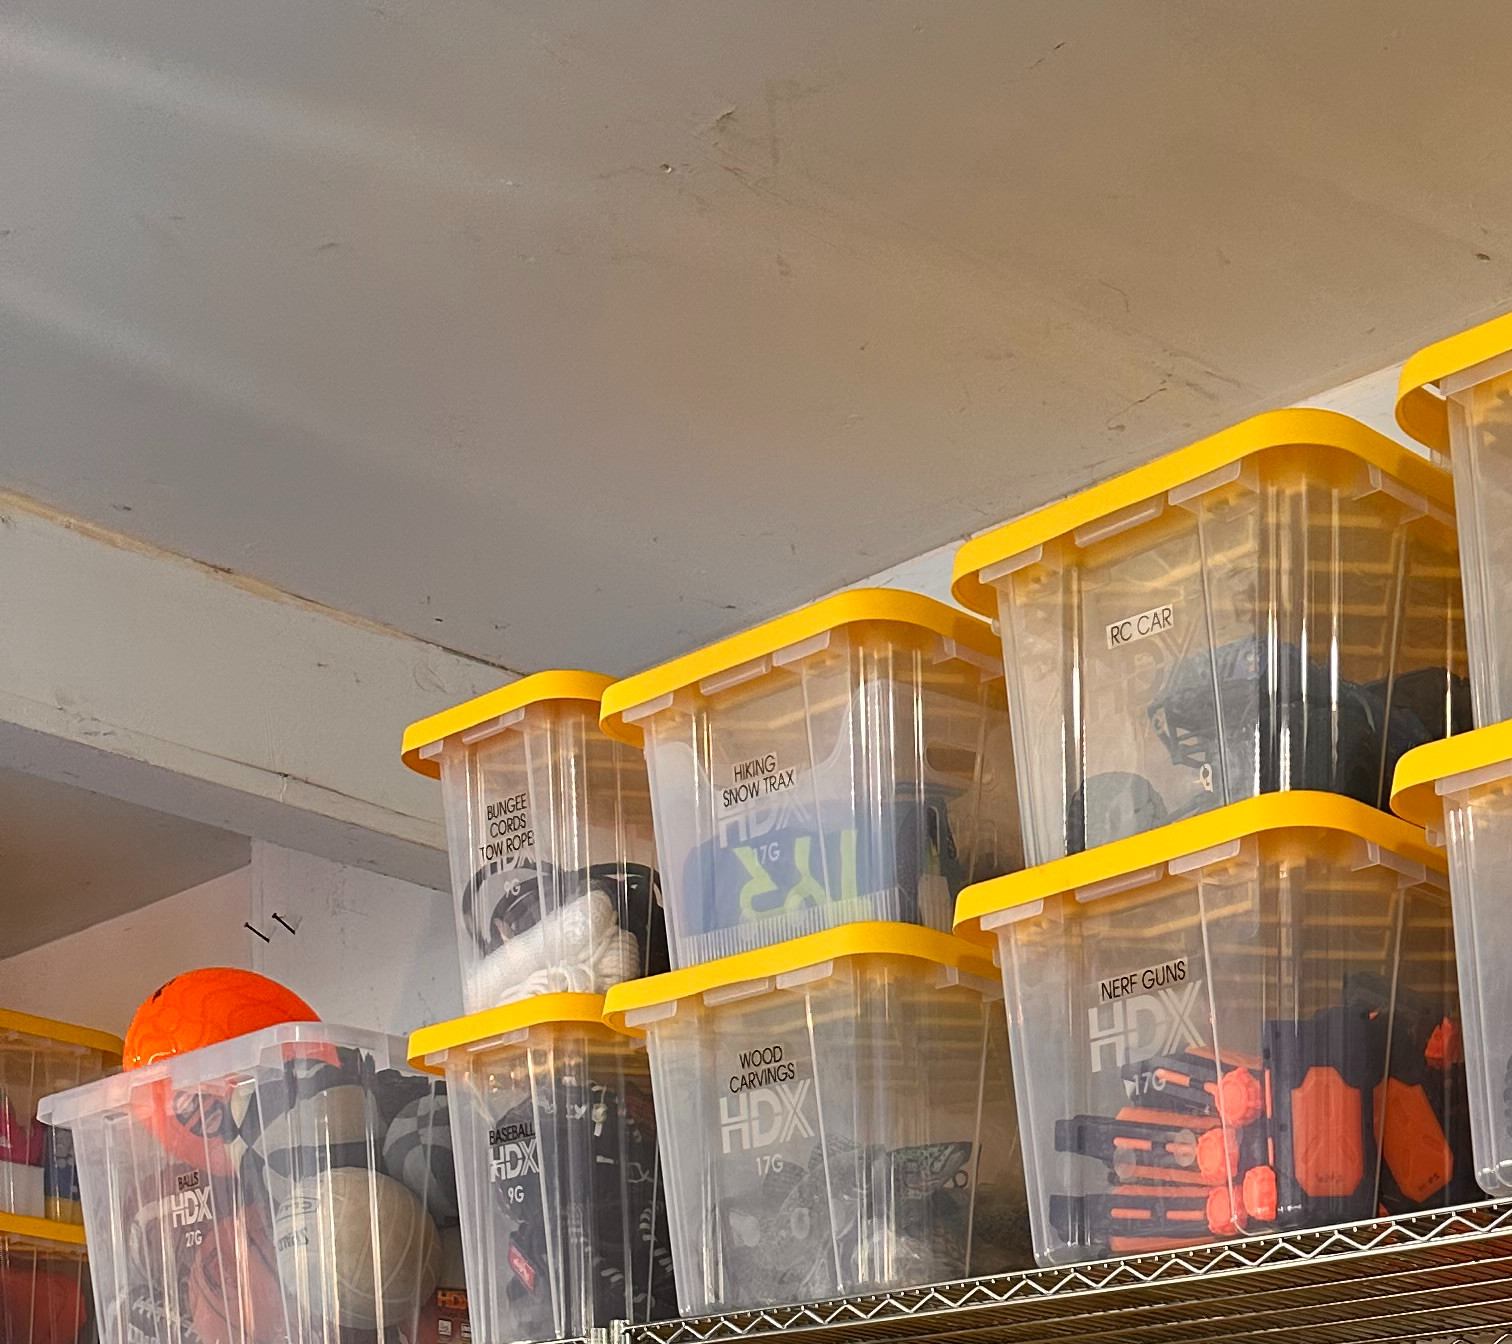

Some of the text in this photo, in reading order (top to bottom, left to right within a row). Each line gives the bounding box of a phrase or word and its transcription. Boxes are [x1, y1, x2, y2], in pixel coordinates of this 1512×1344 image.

[1109, 605, 1174, 647] RC CAR
[733, 754, 777, 782] HIKING
[722, 769, 796, 808] SNOW TRAX
[487, 793, 527, 820] BUNGEE
[490, 813, 526, 838] CORDS
[479, 841, 503, 860] TOW
[504, 879, 521, 898] 9G
[1101, 960, 1186, 1001] NERF GUNS
[1088, 979, 1205, 1073] HDX
[738, 1045, 783, 1070] WOOD
[728, 1062, 796, 1094] CARVINGS
[718, 1080, 816, 1155] HDX
[488, 1123, 536, 1146] BASEBALL
[489, 1139, 540, 1181] HDX
[755, 1153, 785, 1175] 17G
[177, 1171, 199, 1189] BALLS
[172, 1187, 214, 1228] HDX
[506, 1184, 525, 1204] 9G
[185, 1229, 202, 1249] 27G
